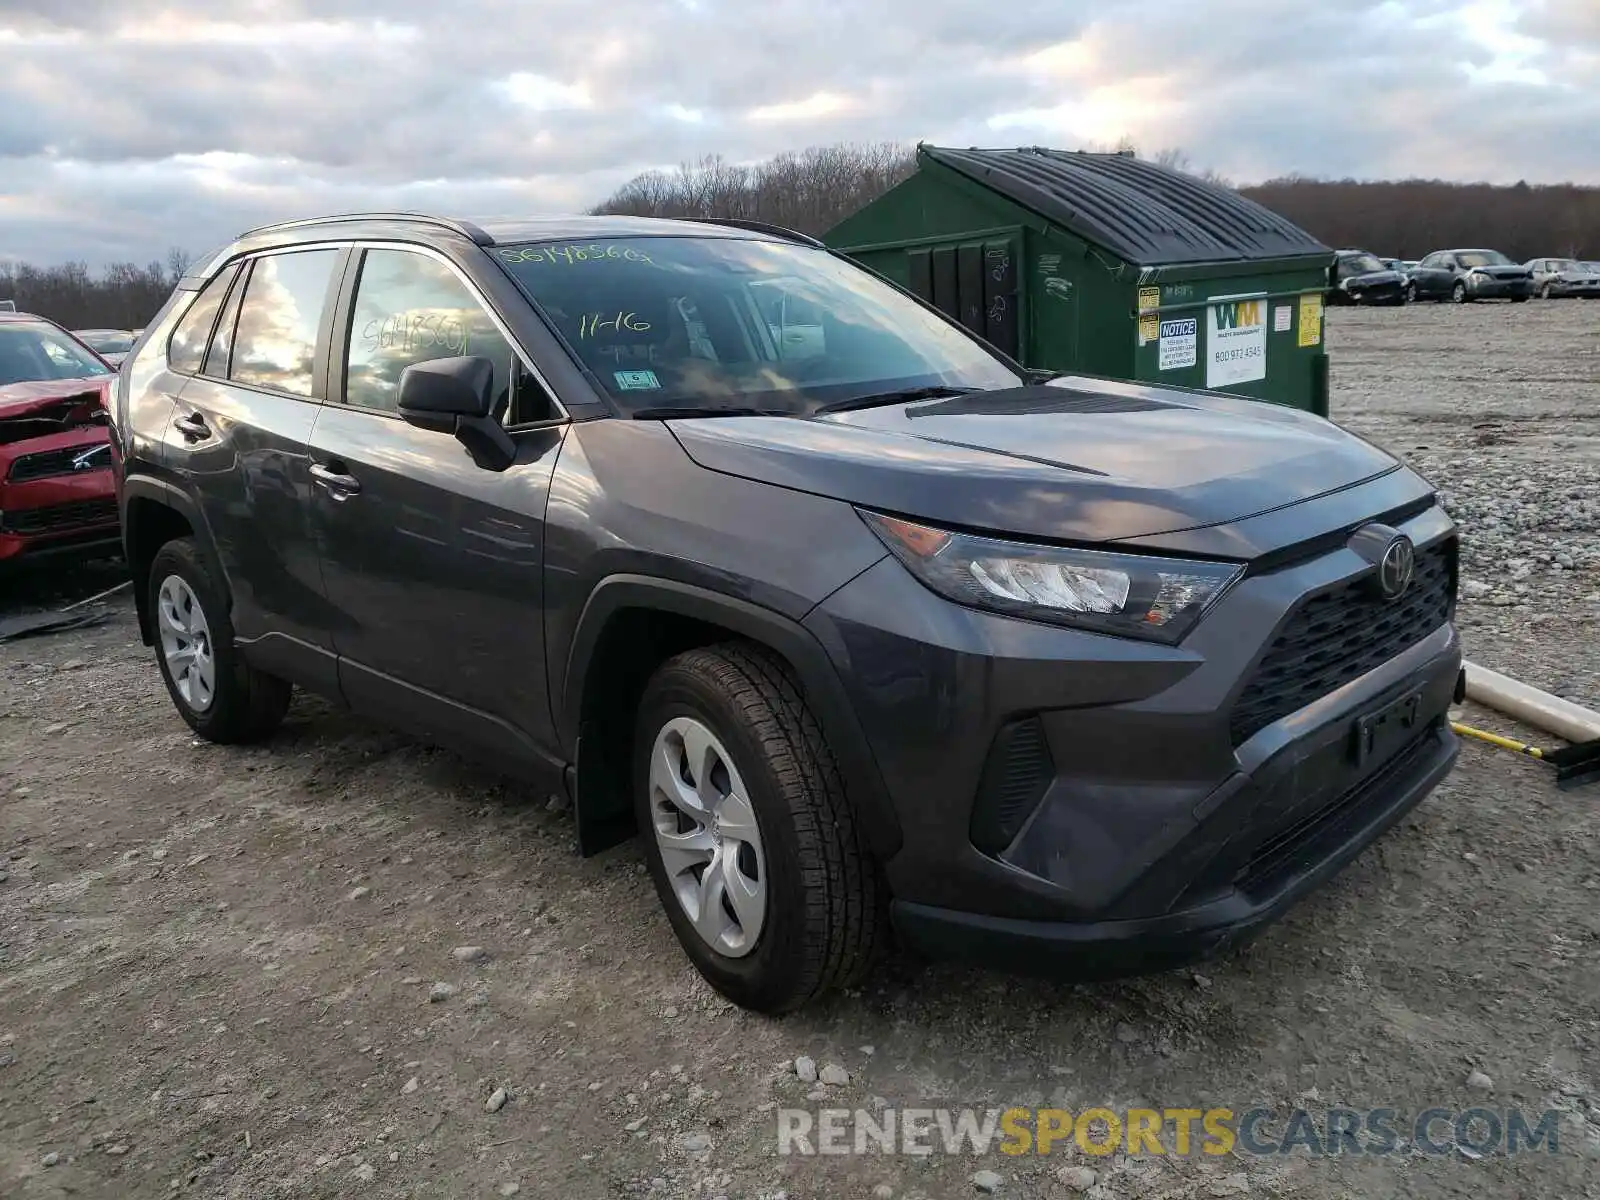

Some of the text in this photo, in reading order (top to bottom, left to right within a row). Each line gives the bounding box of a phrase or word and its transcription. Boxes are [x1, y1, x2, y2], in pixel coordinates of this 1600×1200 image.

[580, 311, 651, 340] 11-16
[1215, 302, 1259, 330] WM
[1162, 321, 1195, 337] NOTICE
[1215, 351, 1230, 362] 800
